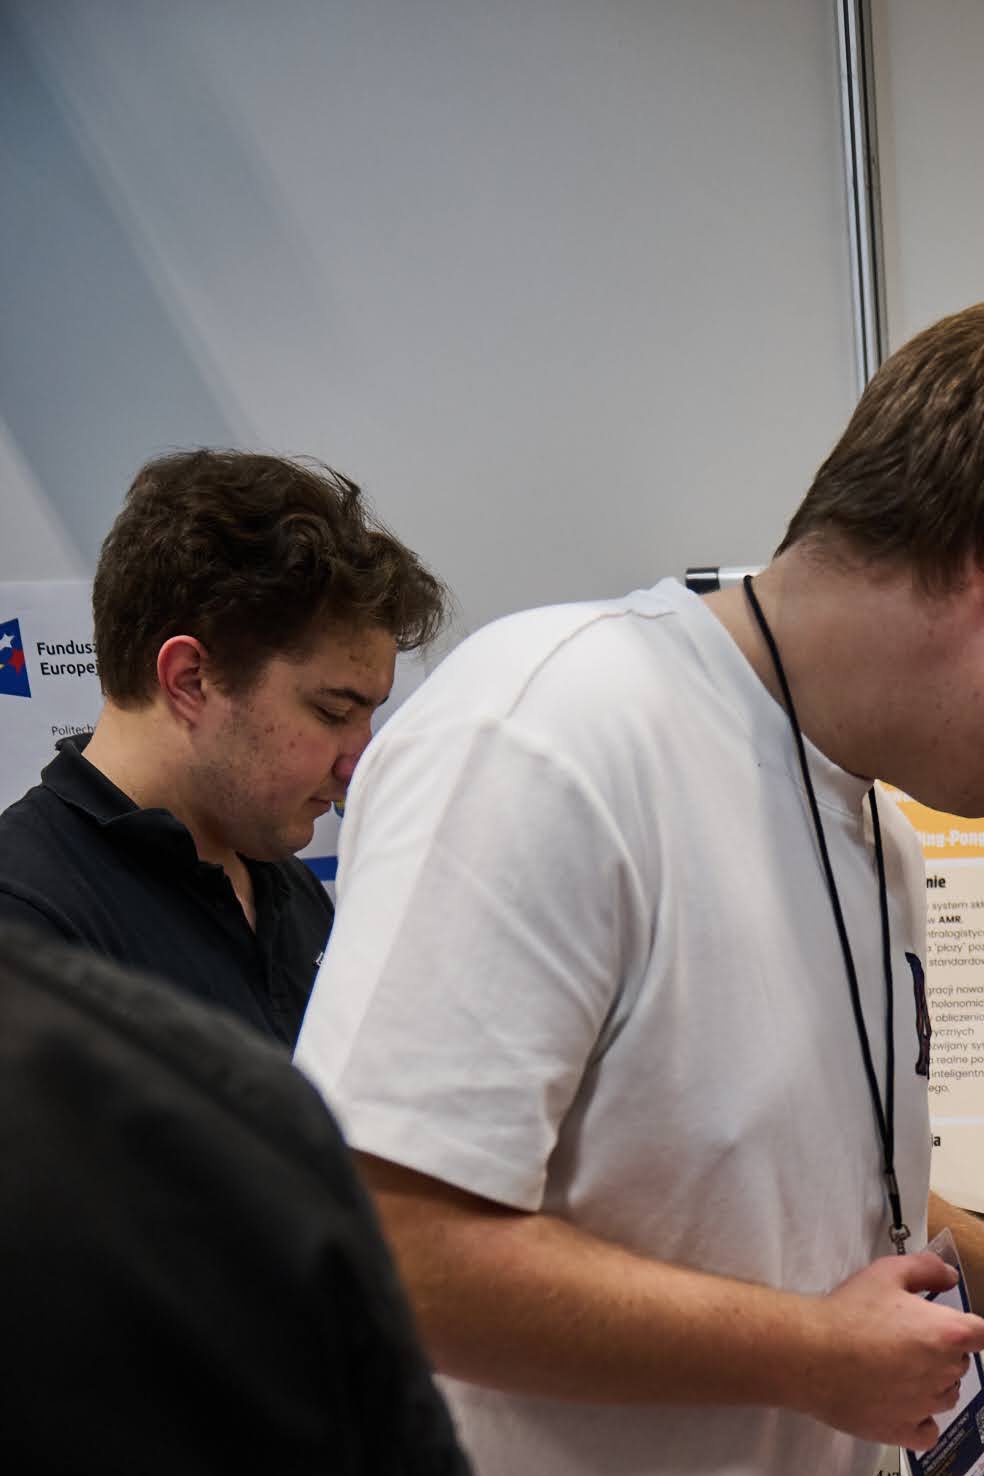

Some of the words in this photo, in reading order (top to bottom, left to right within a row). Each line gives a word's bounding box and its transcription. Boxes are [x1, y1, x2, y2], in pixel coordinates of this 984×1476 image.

[51, 723, 97, 737] Politech
[926, 875, 947, 889] nie
[932, 902, 969, 912] system
[932, 1027, 975, 1038] ycznych
[931, 1041, 968, 1052] zwijany
